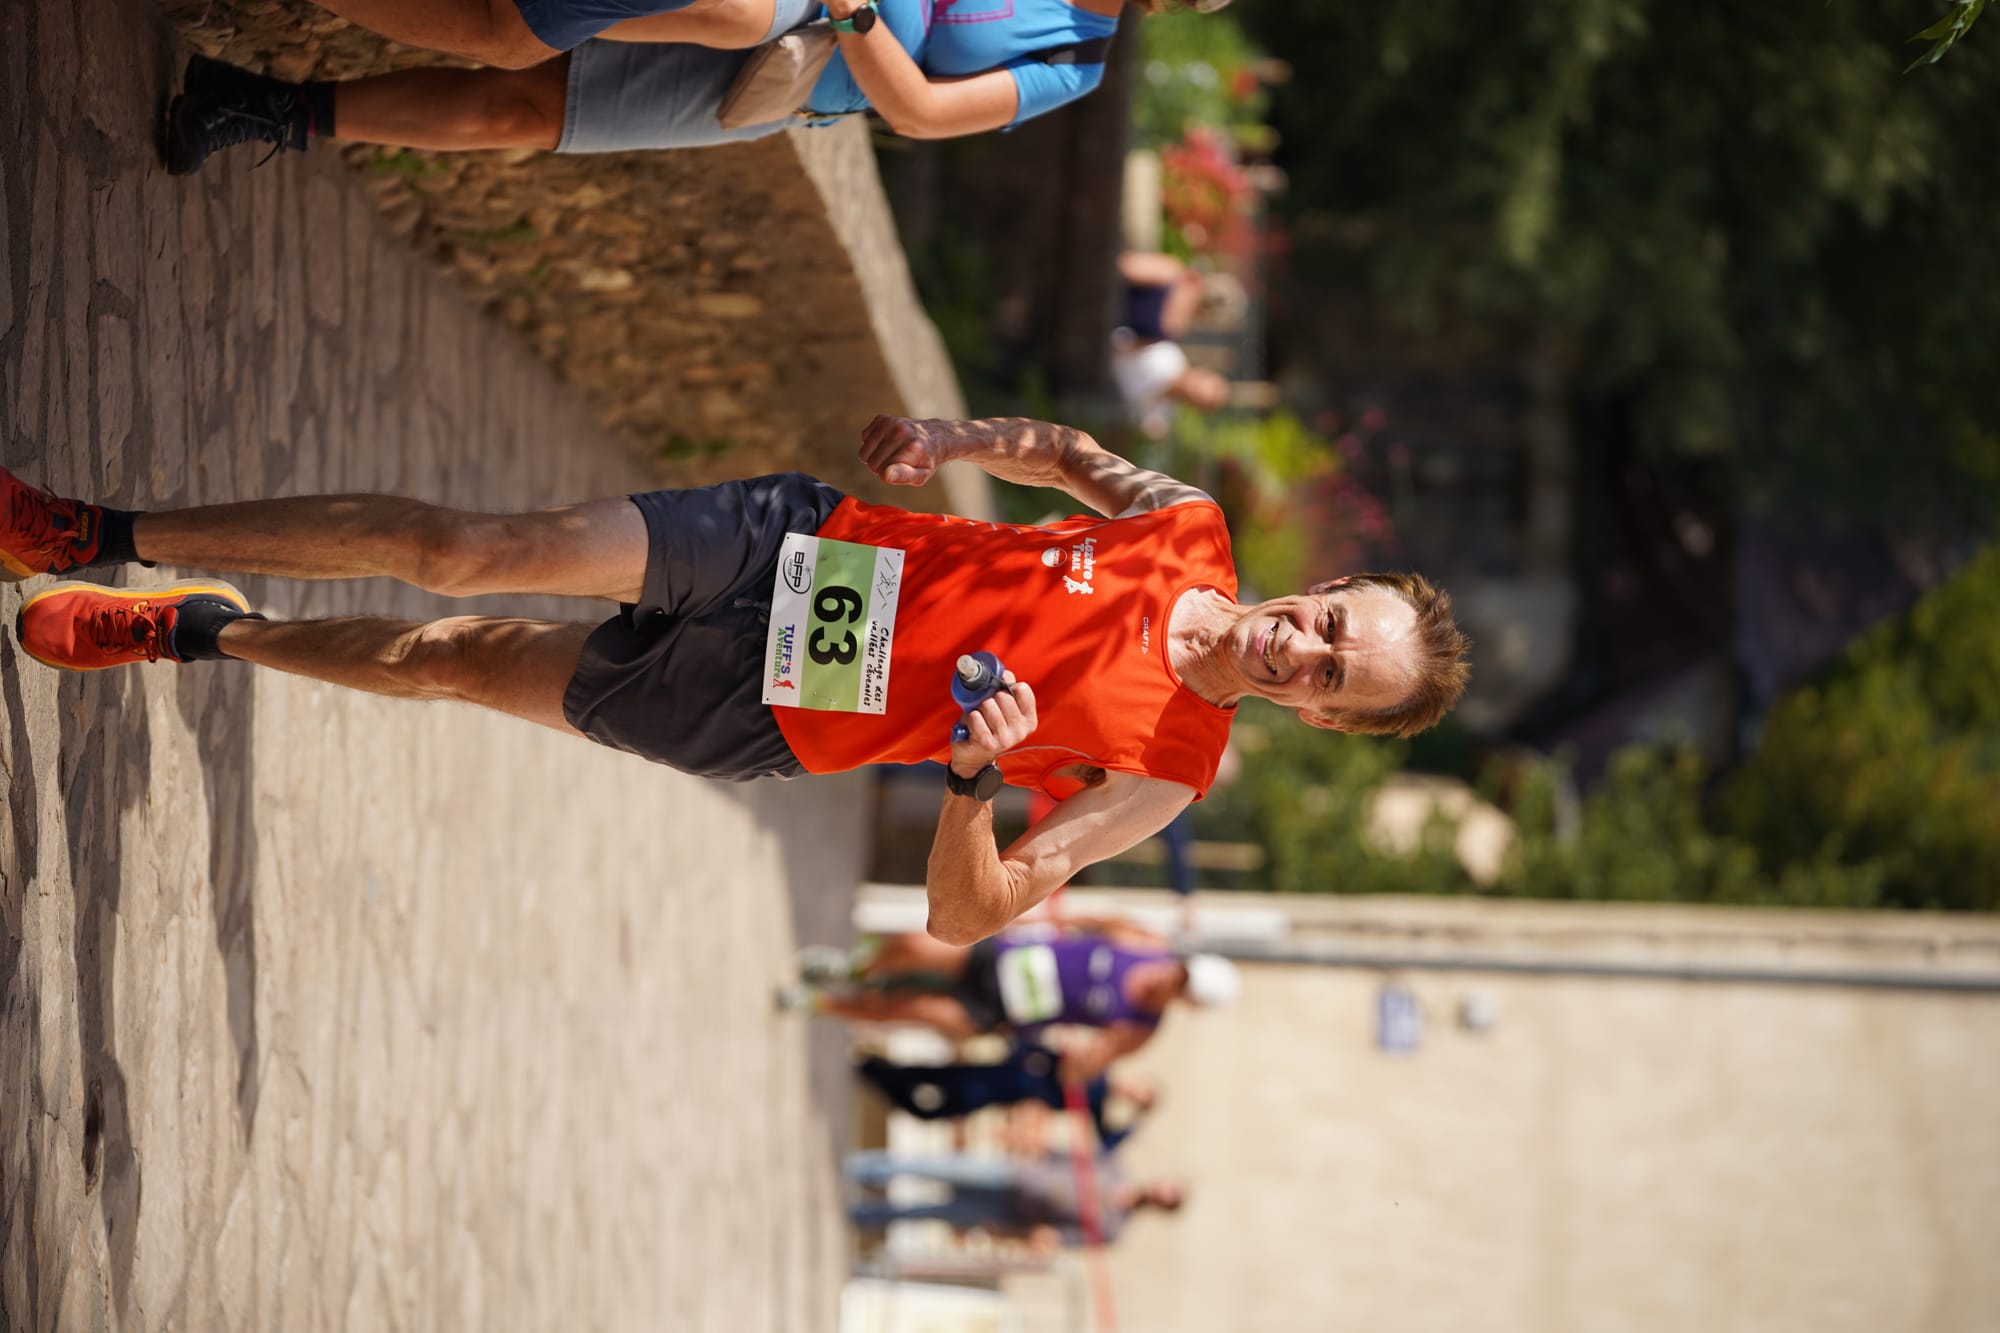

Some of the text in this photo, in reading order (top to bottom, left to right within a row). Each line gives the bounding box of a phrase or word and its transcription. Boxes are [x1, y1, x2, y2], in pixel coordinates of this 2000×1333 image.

[792, 552, 805, 587] BFP
[774, 628, 786, 678] Aventure
[781, 624, 795, 674] TUFF'S
[808, 586, 863, 665] 63
[864, 621, 878, 706] vallées cévenoles
[874, 628, 889, 702] Challenge des
